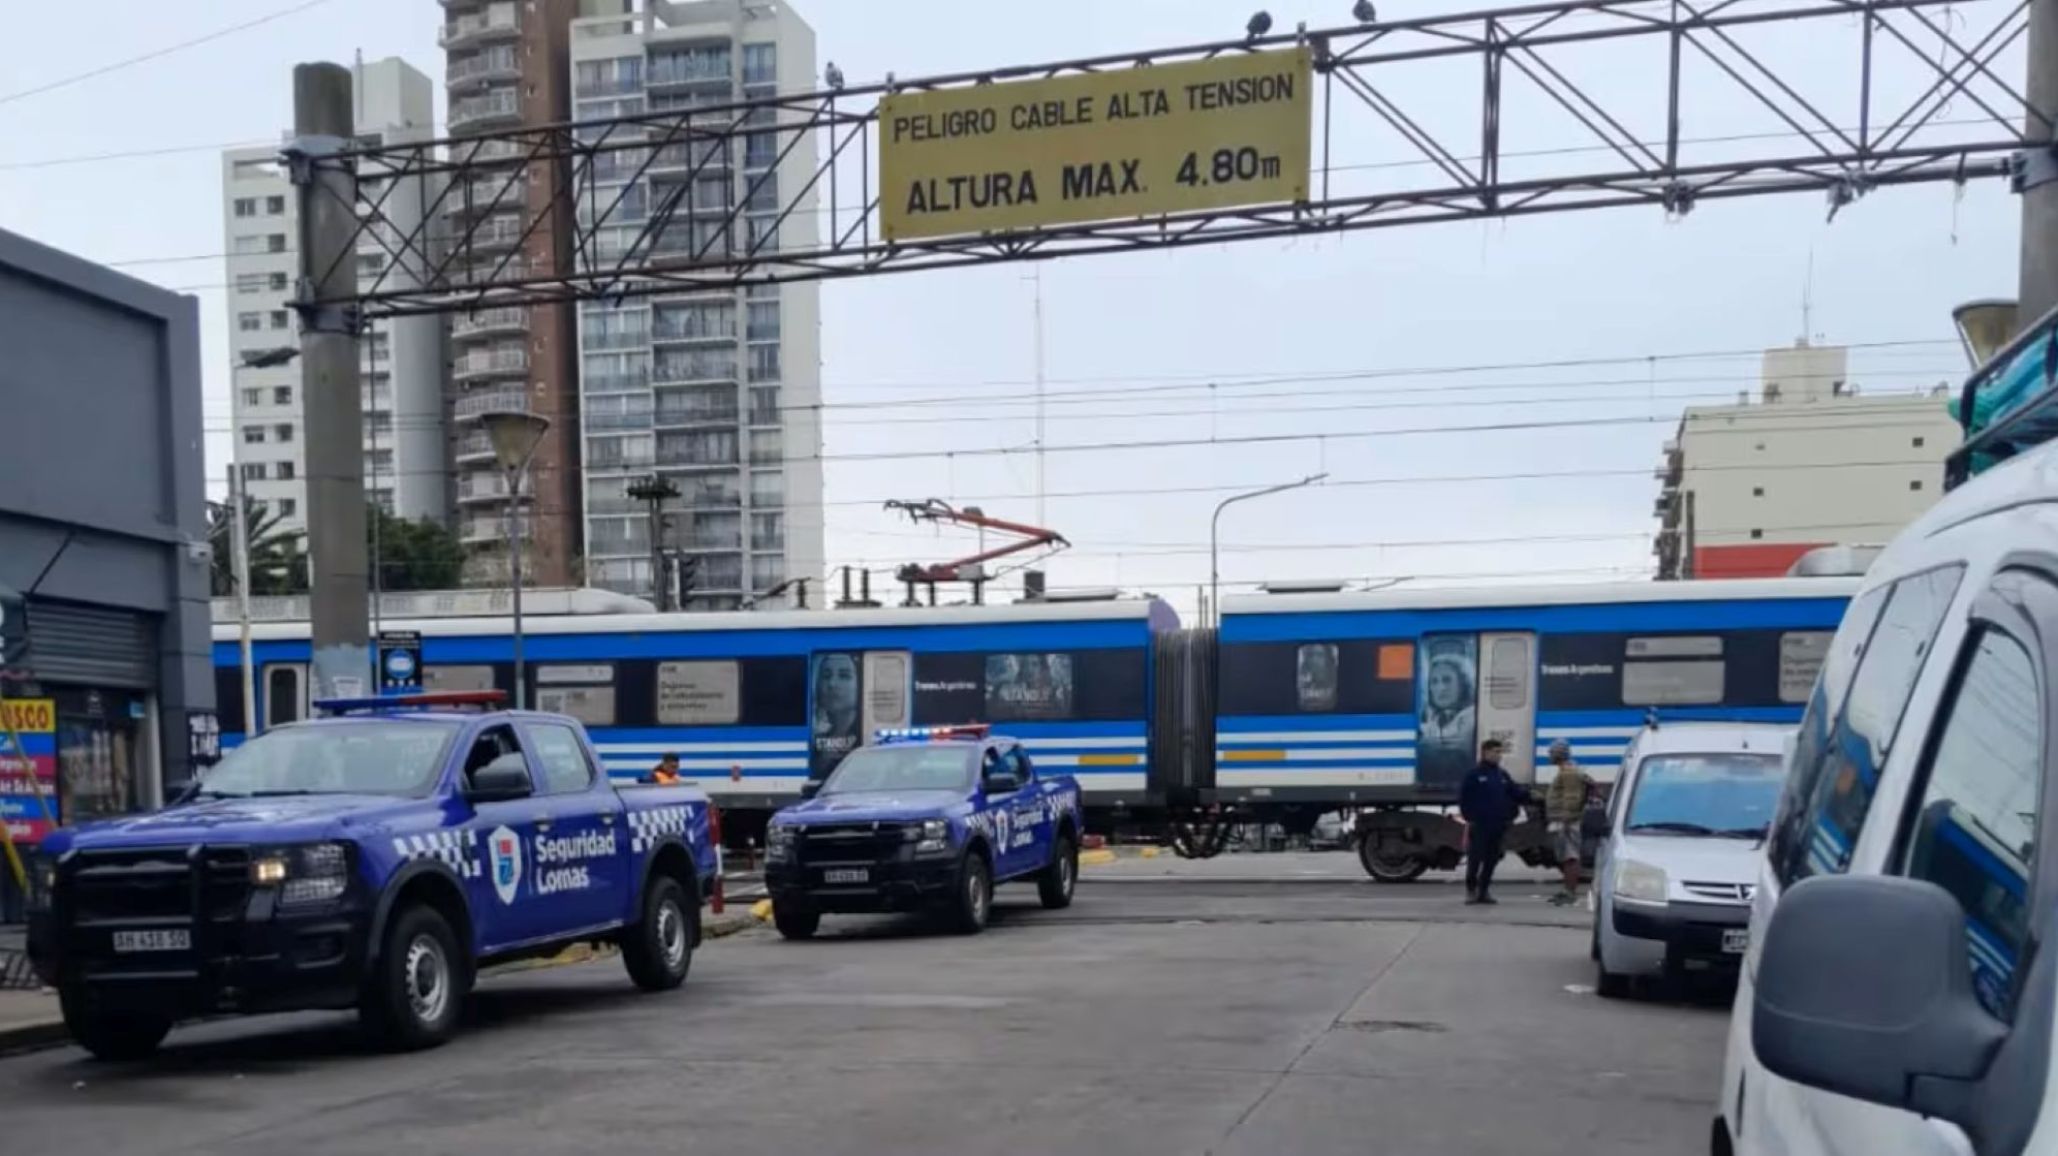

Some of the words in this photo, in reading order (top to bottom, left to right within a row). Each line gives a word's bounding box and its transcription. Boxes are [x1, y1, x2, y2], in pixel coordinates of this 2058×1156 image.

[893, 108, 997, 143] PELIGRO
[1011, 97, 1094, 131] CABLE
[1107, 88, 1171, 121] ALTA
[1185, 73, 1295, 112] TENSION
[907, 170, 1039, 215] ALTURA
[1062, 159, 1149, 201] MAX.
[1176, 146, 1282, 188] 4.80m
[535, 828, 616, 864] Seguridad
[536, 866, 591, 895] Lomas
